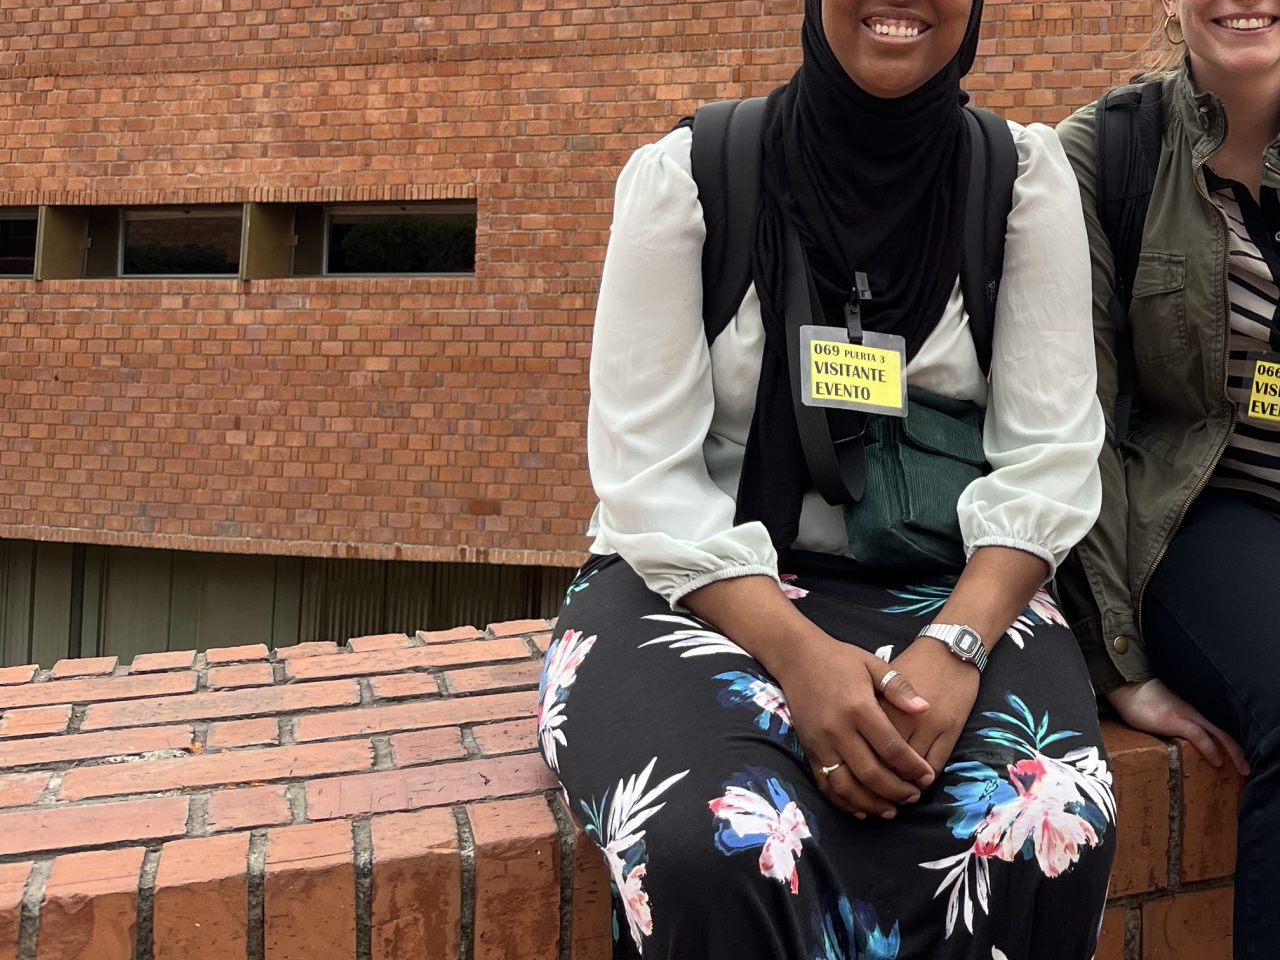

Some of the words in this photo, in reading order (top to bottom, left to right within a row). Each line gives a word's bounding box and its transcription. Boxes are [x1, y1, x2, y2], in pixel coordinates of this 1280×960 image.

[814, 343, 840, 356] 069
[844, 349, 876, 362] PUERTA
[814, 361, 887, 382] VISITANTE
[815, 381, 870, 400] EVENTO
